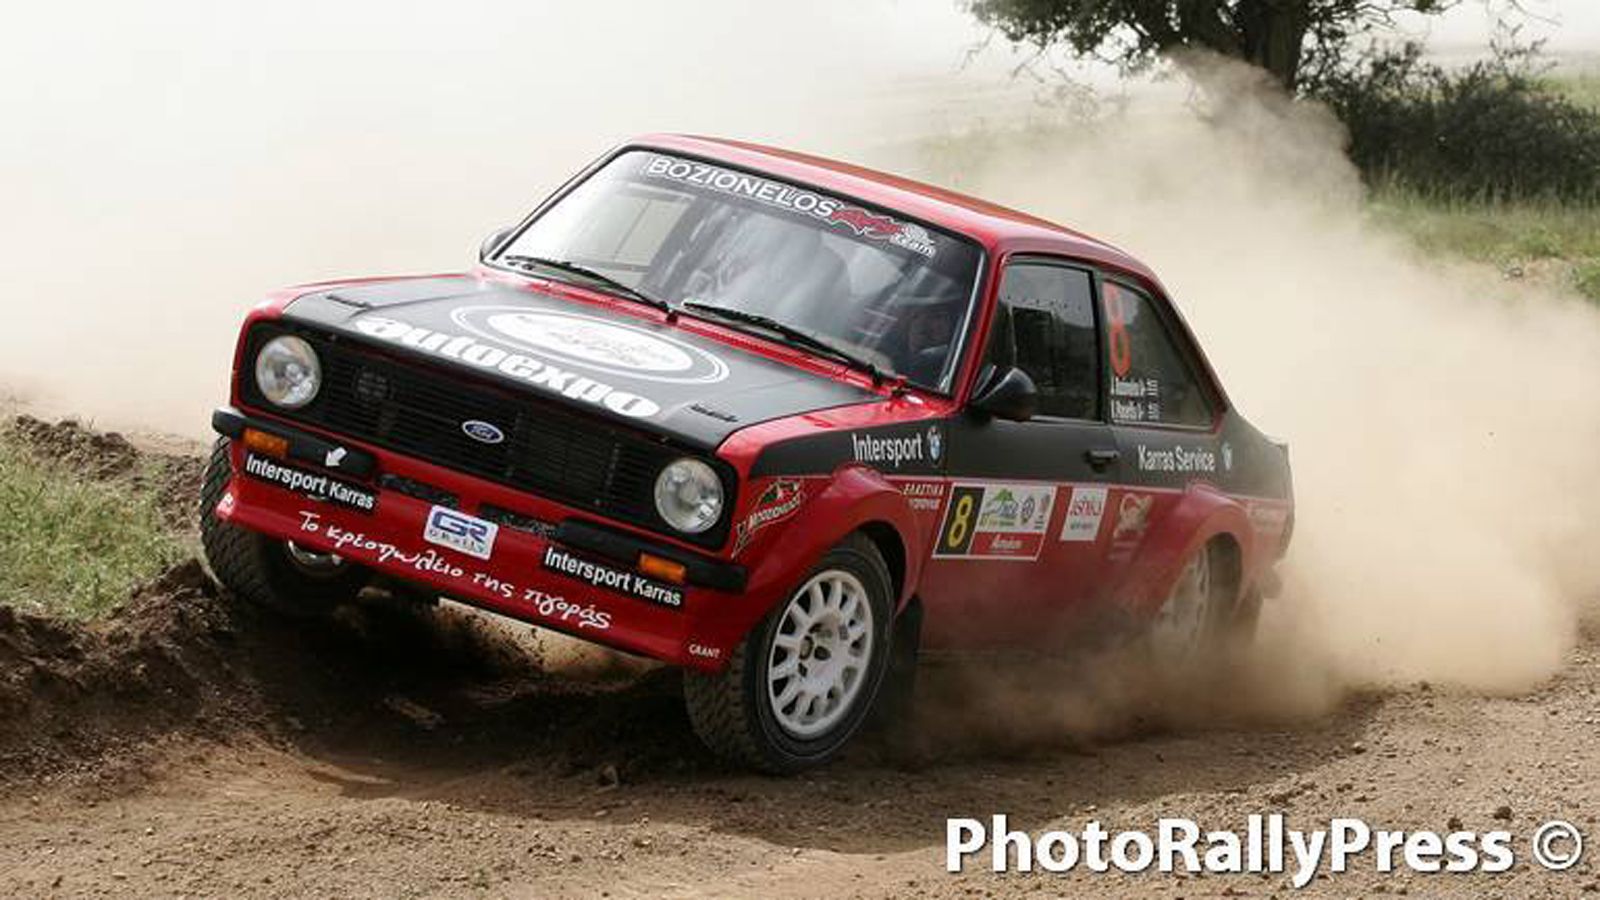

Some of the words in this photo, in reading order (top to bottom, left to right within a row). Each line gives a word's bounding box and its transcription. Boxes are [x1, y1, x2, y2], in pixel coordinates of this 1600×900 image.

[648, 157, 837, 218] BOZIONELOS
[1102, 281, 1132, 377] 8
[355, 316, 661, 418] autoexpo
[851, 431, 924, 467] Intersport
[1137, 443, 1174, 470] Karras
[1174, 443, 1216, 471] Service
[245, 453, 327, 495] Intersport
[328, 481, 375, 510] Karras
[948, 494, 974, 548] 8
[543, 546, 633, 591] Intersport
[633, 577, 682, 607] Karras
